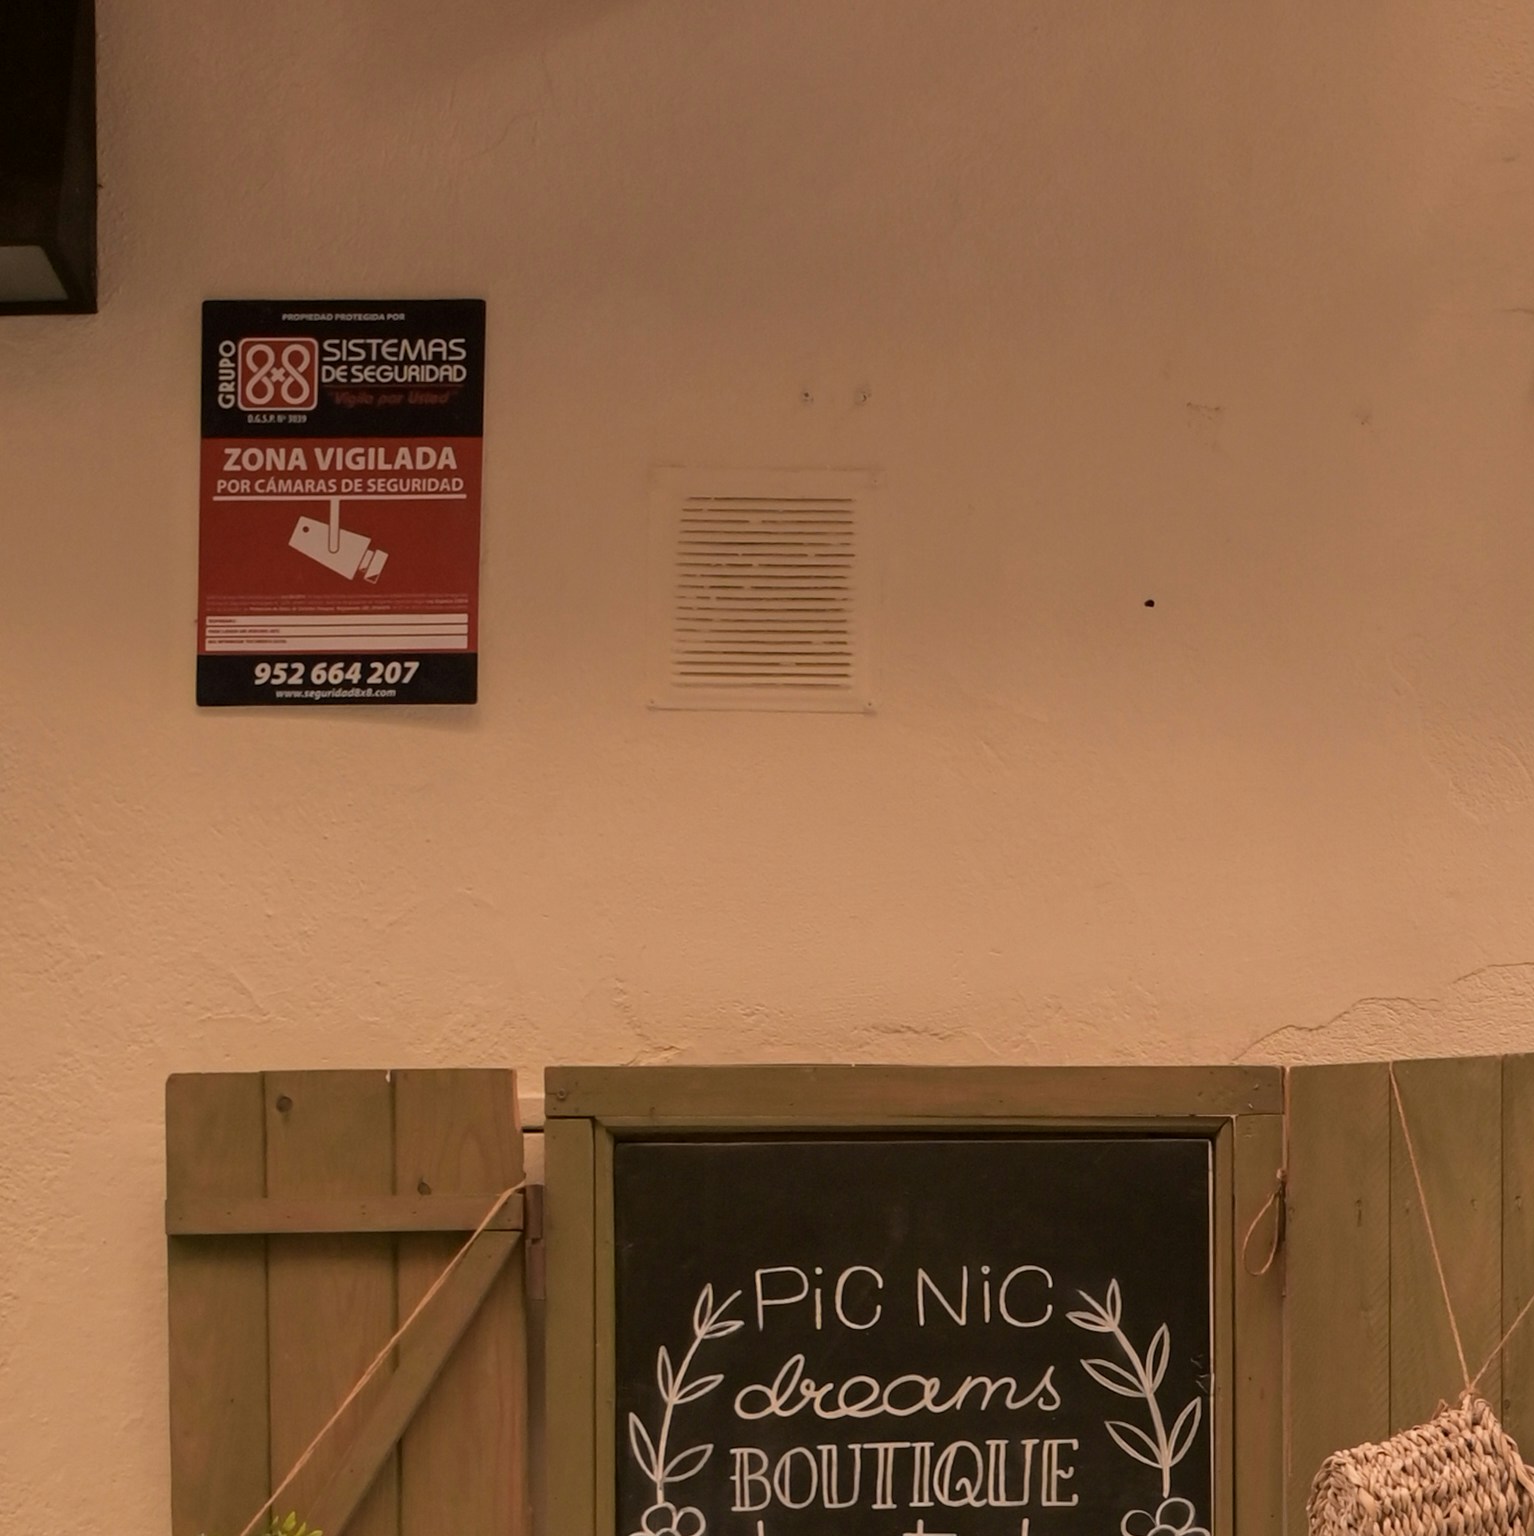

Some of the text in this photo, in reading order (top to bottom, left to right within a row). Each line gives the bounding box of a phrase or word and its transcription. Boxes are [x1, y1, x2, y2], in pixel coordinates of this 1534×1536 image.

[281, 312, 406, 321] PROPIEDAD PROTEGIDA POR
[322, 338, 467, 362] SISTEMAS
[217, 340, 236, 410] GRUPO
[321, 364, 467, 383] DE SEGURIDAD
[223, 446, 458, 471] ZONA VIGILADA
[217, 476, 464, 493] POR CÁMARAS DE SEGURIDAD
[254, 661, 420, 685] 952 664 207
[275, 687, 397, 700] www.seguridad8x8.com
[754, 1264, 1054, 1331] PiC NiC
[733, 1352, 1062, 1420] dreams
[730, 1437, 1080, 1513] BOUTIQUE
